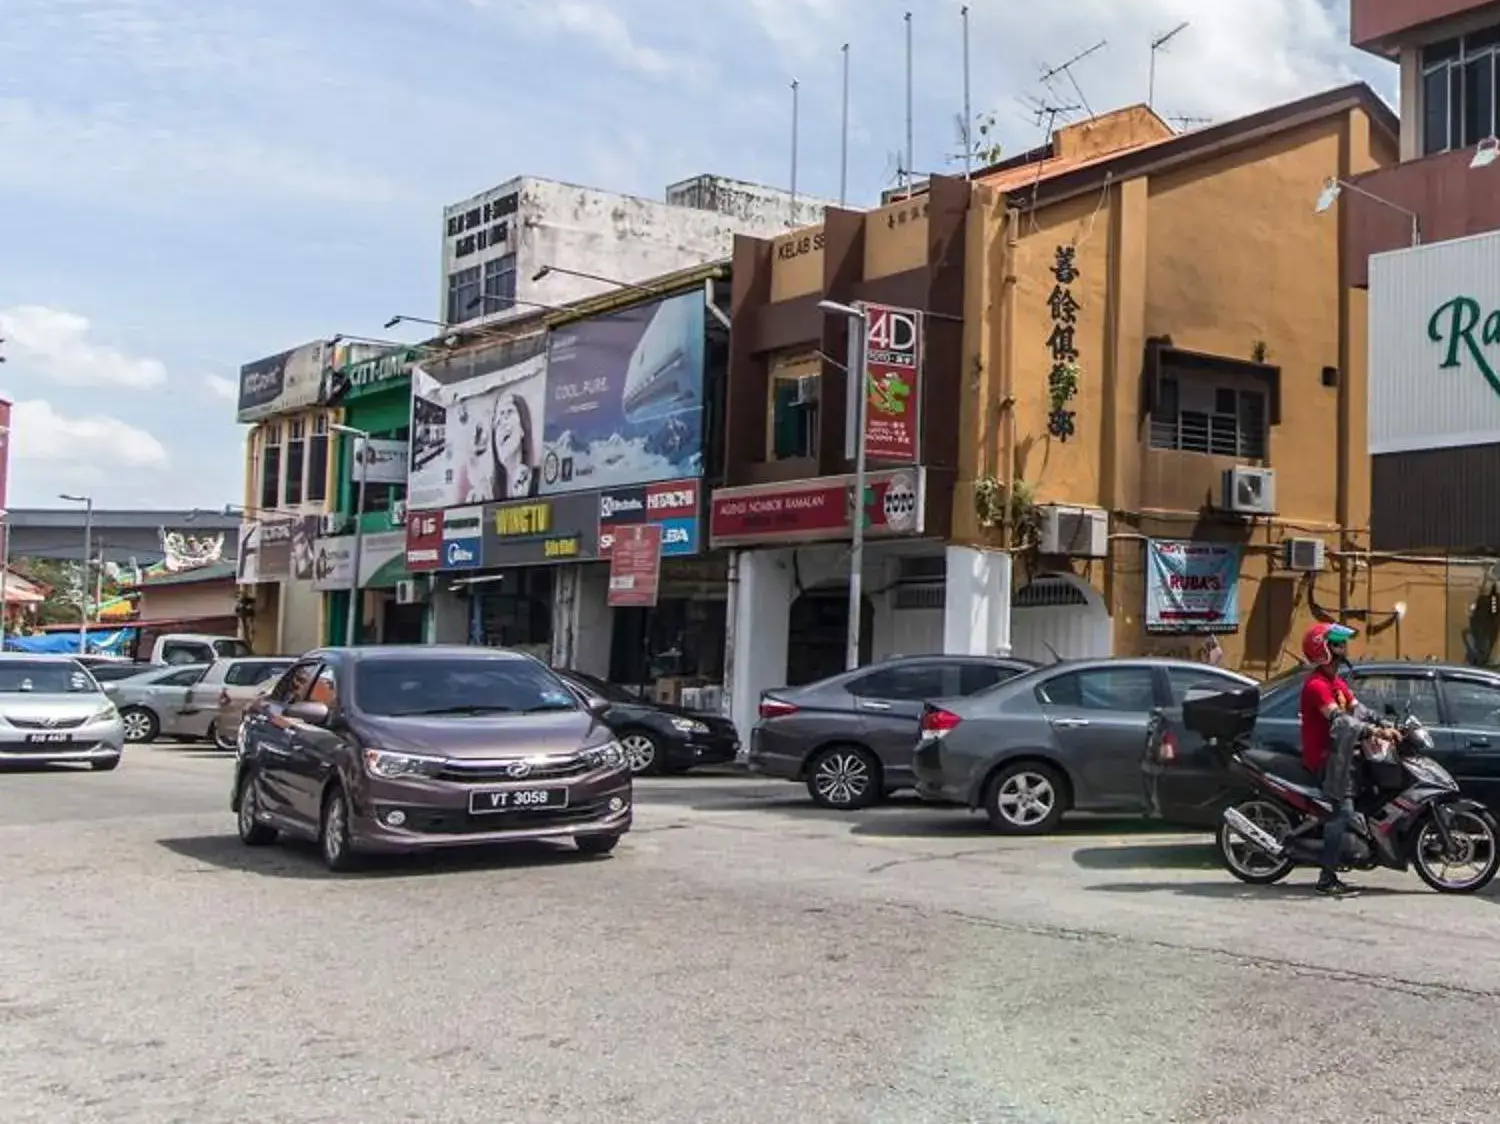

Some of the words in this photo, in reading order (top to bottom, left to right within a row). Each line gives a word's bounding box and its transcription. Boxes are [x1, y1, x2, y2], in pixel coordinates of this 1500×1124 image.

[777, 237, 811, 261] KELAB
[868, 312, 915, 350] 4D
[785, 494, 825, 509] RAMALAN
[490, 792, 508, 807] VT
[513, 790, 549, 805] 3058
